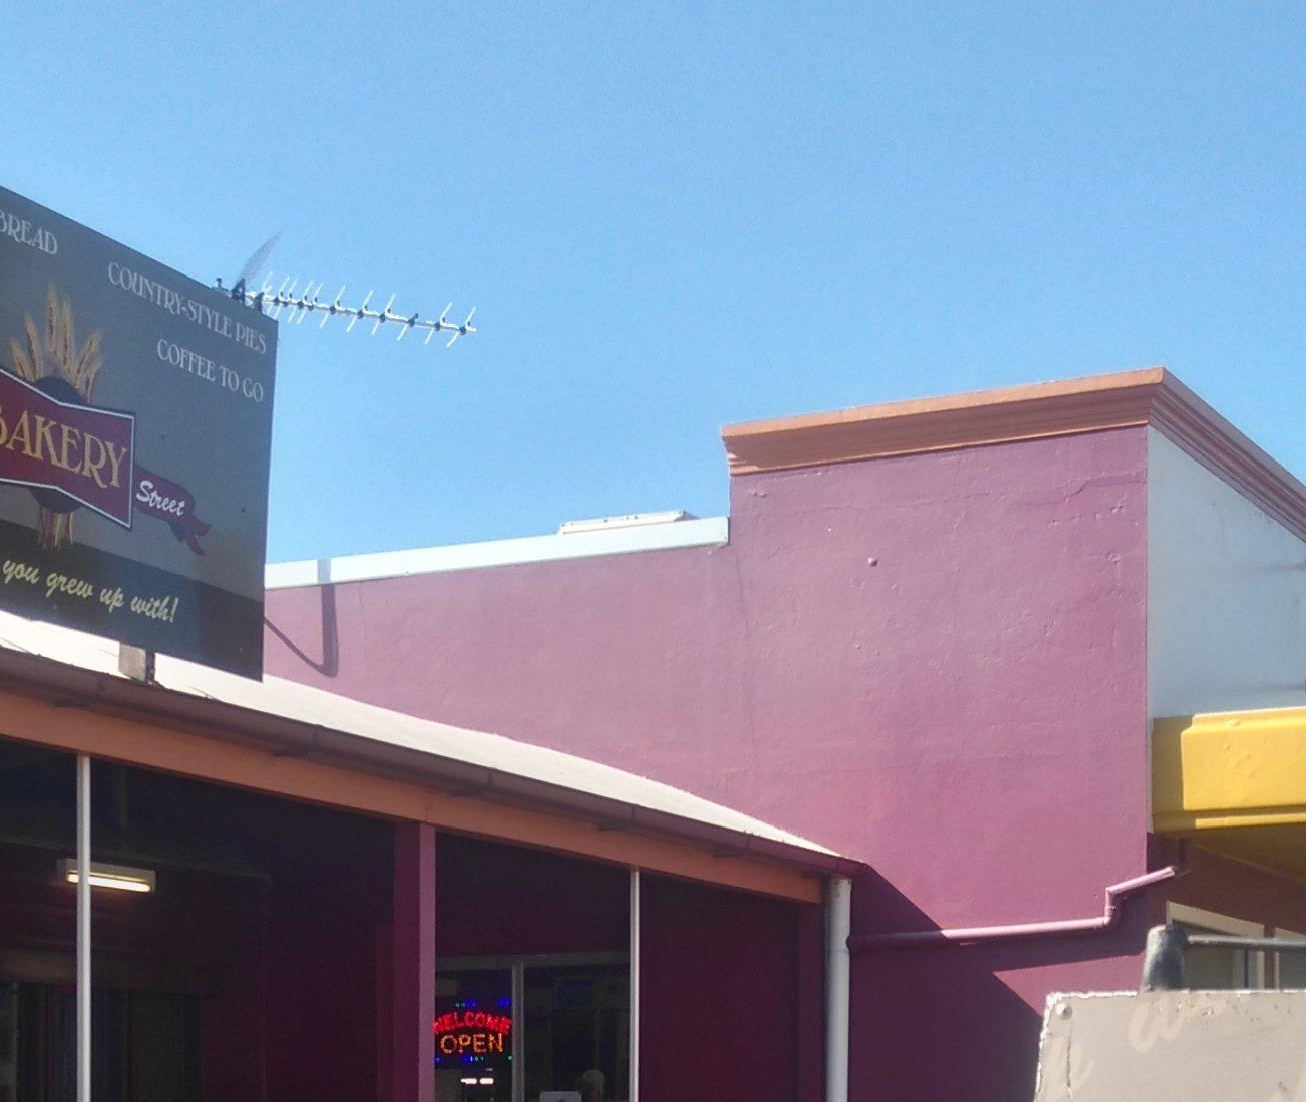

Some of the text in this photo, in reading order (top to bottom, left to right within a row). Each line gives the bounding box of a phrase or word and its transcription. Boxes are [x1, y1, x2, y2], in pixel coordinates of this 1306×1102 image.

[108, 262, 267, 354] COUNTRY-STYLE PIES
[157, 339, 264, 402] COFFEE TO GO
[136, 480, 186, 516] Street
[2, 559, 41, 584] you
[46, 571, 94, 597] grew
[100, 586, 124, 610] up
[131, 596, 180, 623] with!
[440, 1033, 503, 1055] OPEN
